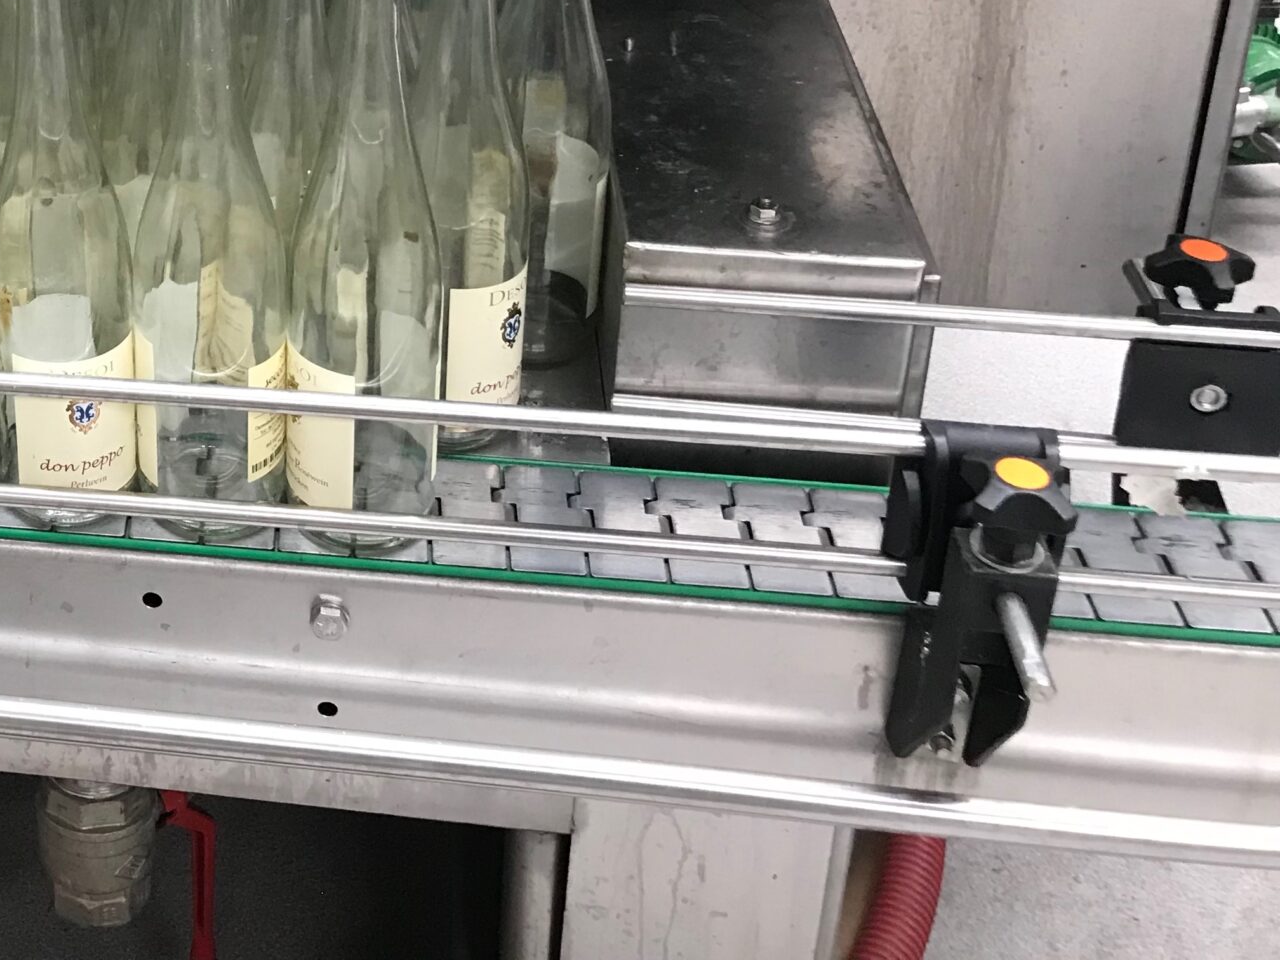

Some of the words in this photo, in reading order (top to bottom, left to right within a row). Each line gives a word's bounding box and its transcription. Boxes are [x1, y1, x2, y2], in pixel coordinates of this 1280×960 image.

[470, 382, 503, 396] don
[40, 458, 78, 472] don
[80, 445, 125, 475] peppo
